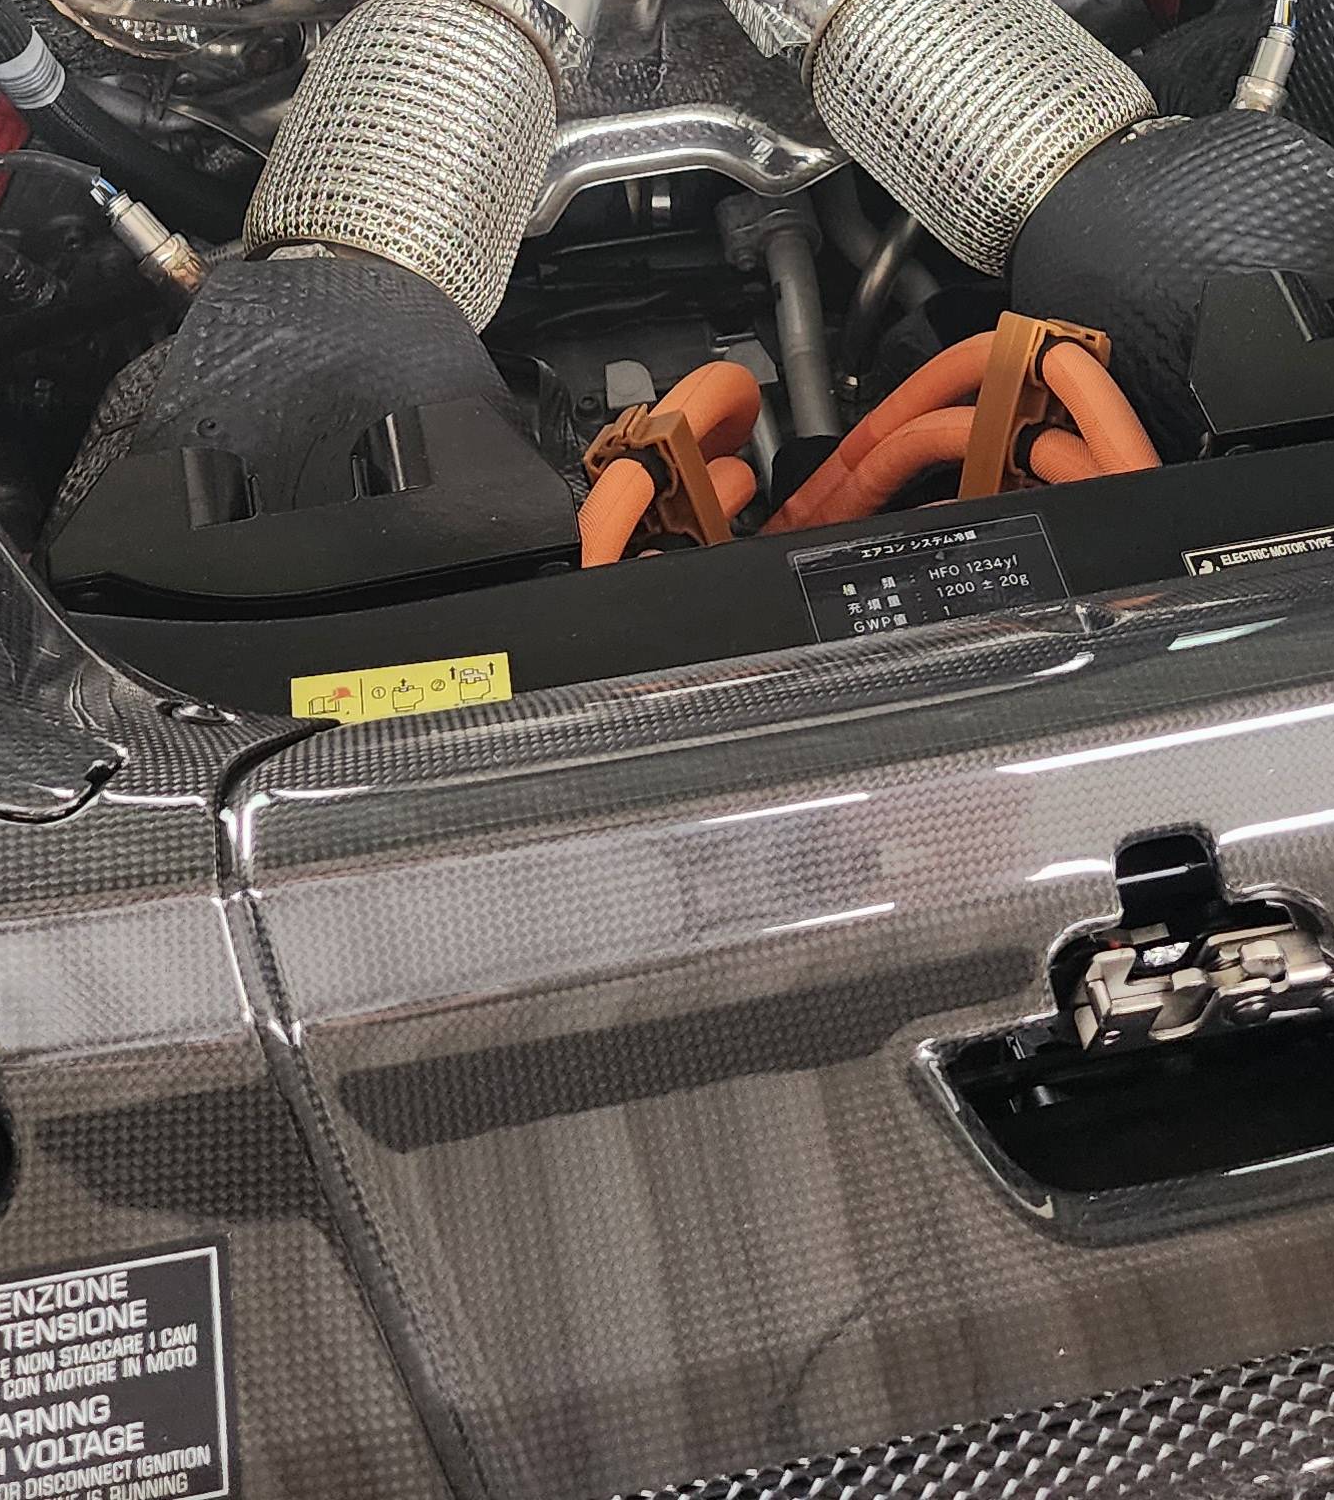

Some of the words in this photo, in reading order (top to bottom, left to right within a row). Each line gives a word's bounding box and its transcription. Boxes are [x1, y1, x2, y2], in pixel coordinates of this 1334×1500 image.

[860, 544, 905, 558] エアコン
[1220, 548, 1269, 566] ELECTRIC
[1269, 542, 1308, 558] MOTOR
[1307, 536, 1334, 551] TYPE
[928, 565, 960, 580] HFO
[936, 581, 975, 597] 1200
[0, 1299, 147, 1350] TENSIONE
[0, 1358, 11, 1379] E
[15, 1349, 55, 1377] NON
[58, 1332, 144, 1368] STACCARE
[160, 1323, 198, 1348] CAVI
[2, 1374, 41, 1400] CON
[45, 1362, 116, 1393] MOTORE
[121, 1356, 141, 1379] IN
[146, 1345, 198, 1373] MOTO
[12, 1421, 145, 1474] VOLTAGE
[25, 1459, 133, 1500] DISCONNECT
[136, 1444, 211, 1479] IGNITION
[109, 1471, 189, 1500] RUNNING
